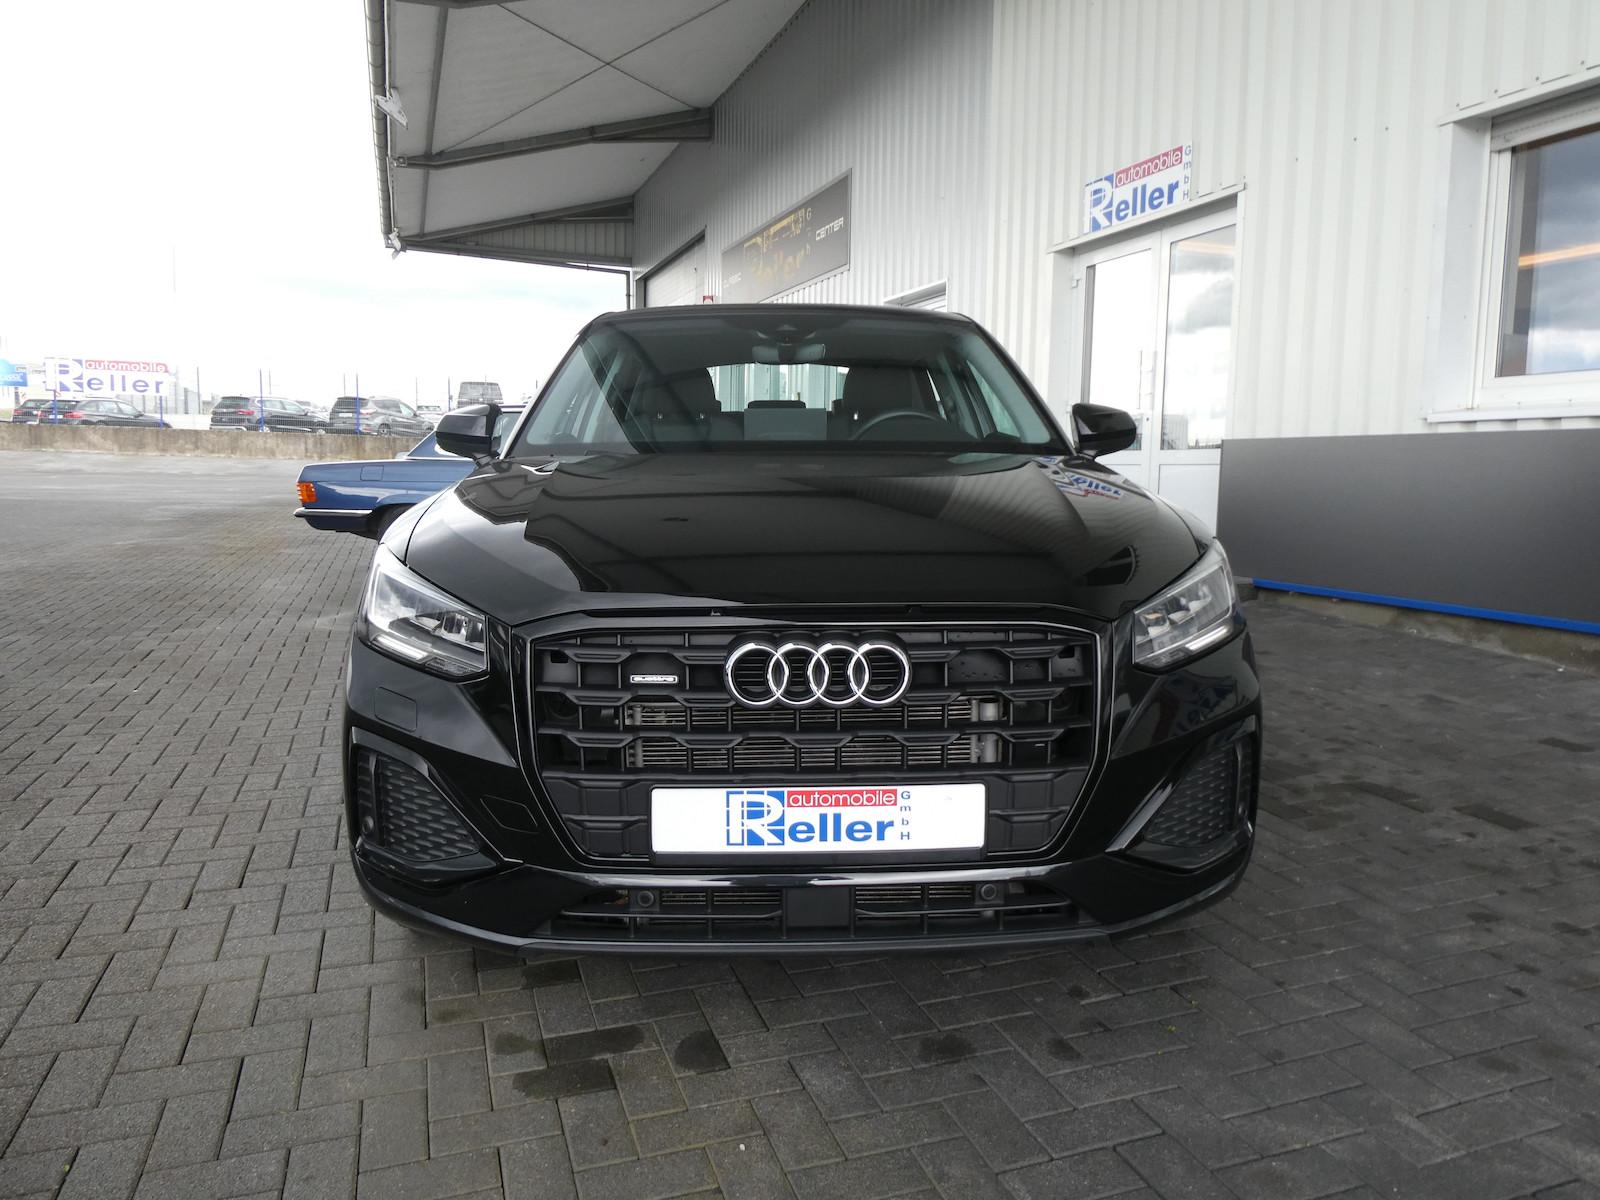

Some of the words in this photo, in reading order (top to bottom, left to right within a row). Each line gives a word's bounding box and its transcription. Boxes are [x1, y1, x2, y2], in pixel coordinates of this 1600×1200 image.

[1116, 150, 1182, 186] automobile
[86, 360, 166, 373] automobile
[789, 791, 896, 807] automobile
[726, 790, 895, 846] Reller
